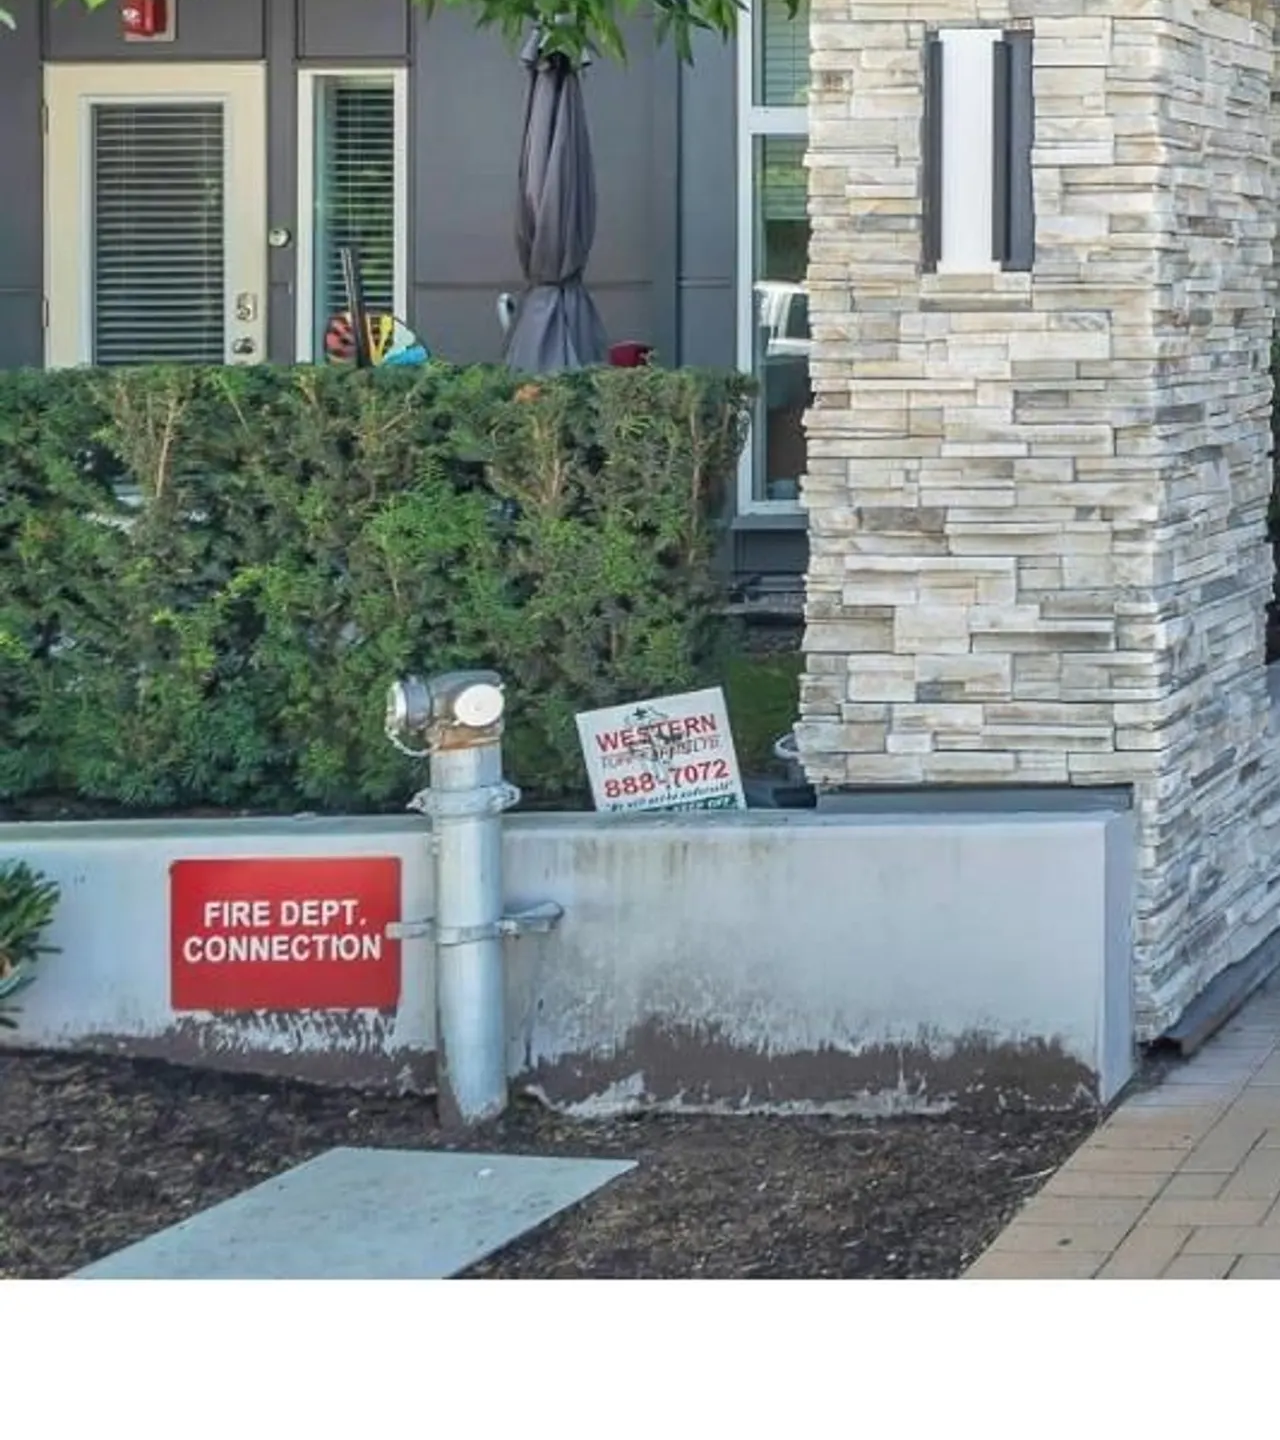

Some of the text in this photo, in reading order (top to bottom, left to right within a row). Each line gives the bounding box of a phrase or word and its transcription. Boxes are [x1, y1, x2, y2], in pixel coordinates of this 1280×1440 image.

[595, 714, 717, 753] WESTERN
[604, 758, 730, 798] 888-7072
[204, 899, 367, 927] FIRE DEPT.
[183, 934, 382, 962] CONNECTION
